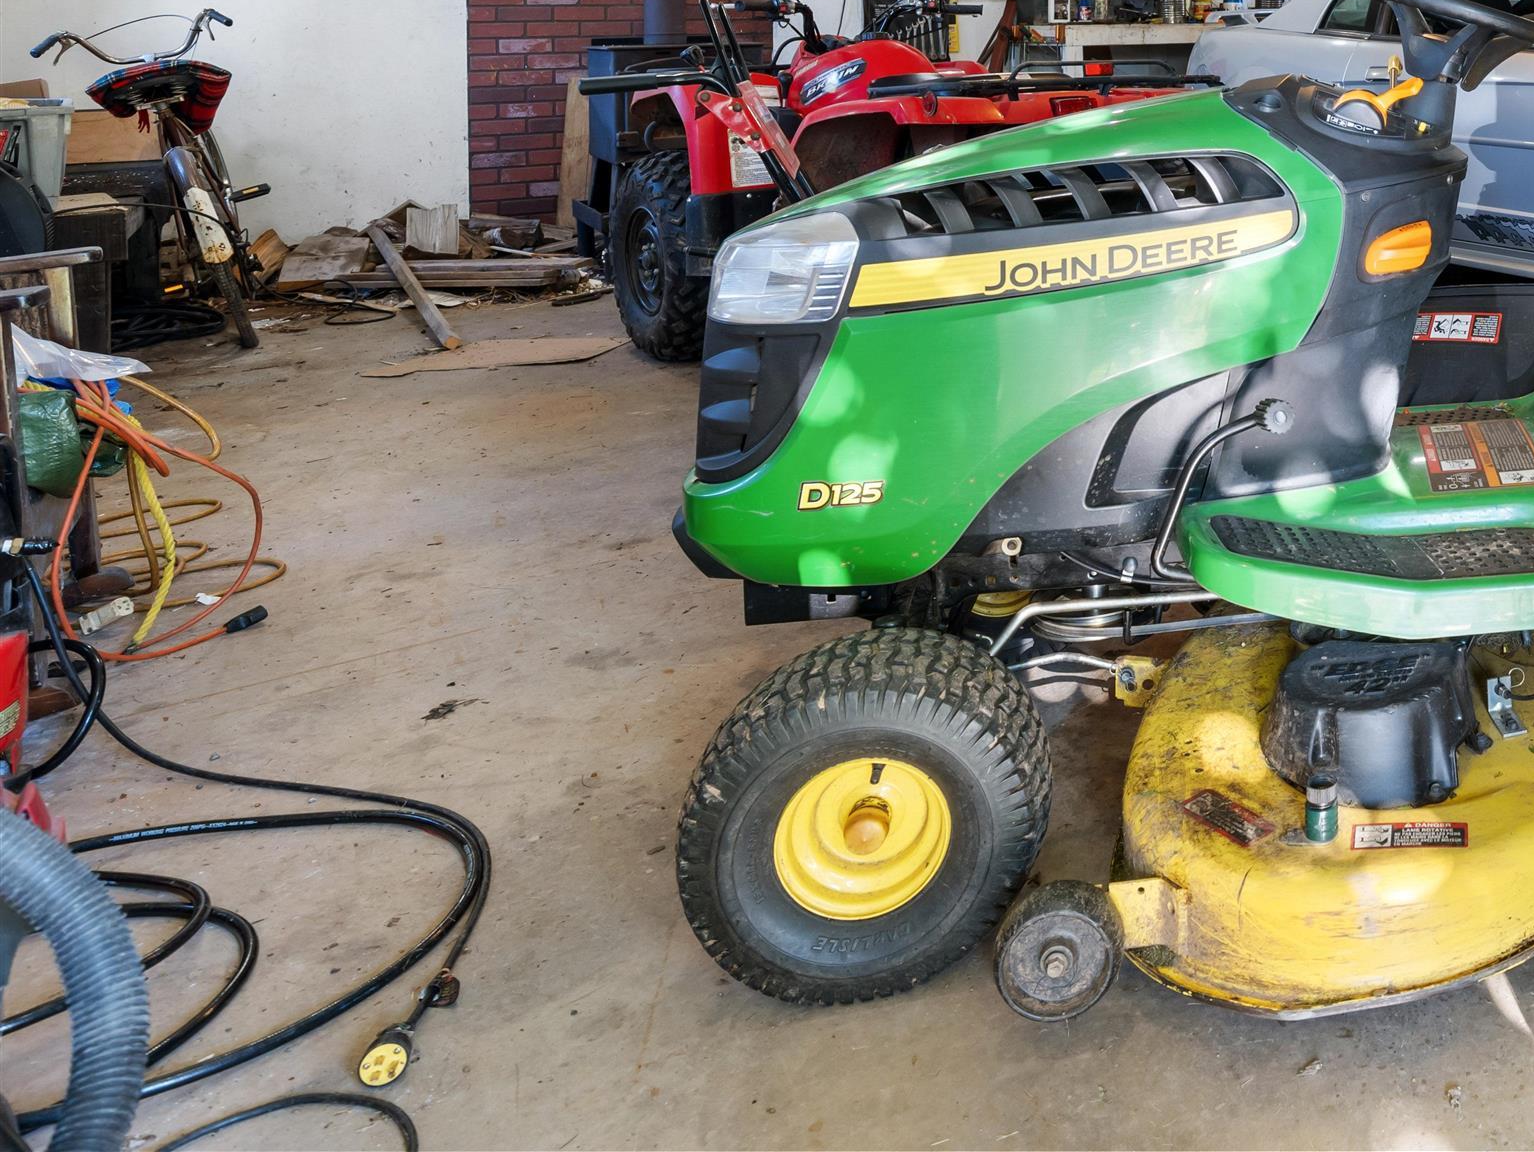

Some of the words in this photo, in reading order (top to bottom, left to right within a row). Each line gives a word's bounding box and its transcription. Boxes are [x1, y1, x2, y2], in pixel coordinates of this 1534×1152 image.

[985, 254, 1097, 292] JOHN
[1108, 230, 1239, 274] DEERE
[798, 480, 884, 511] D125
